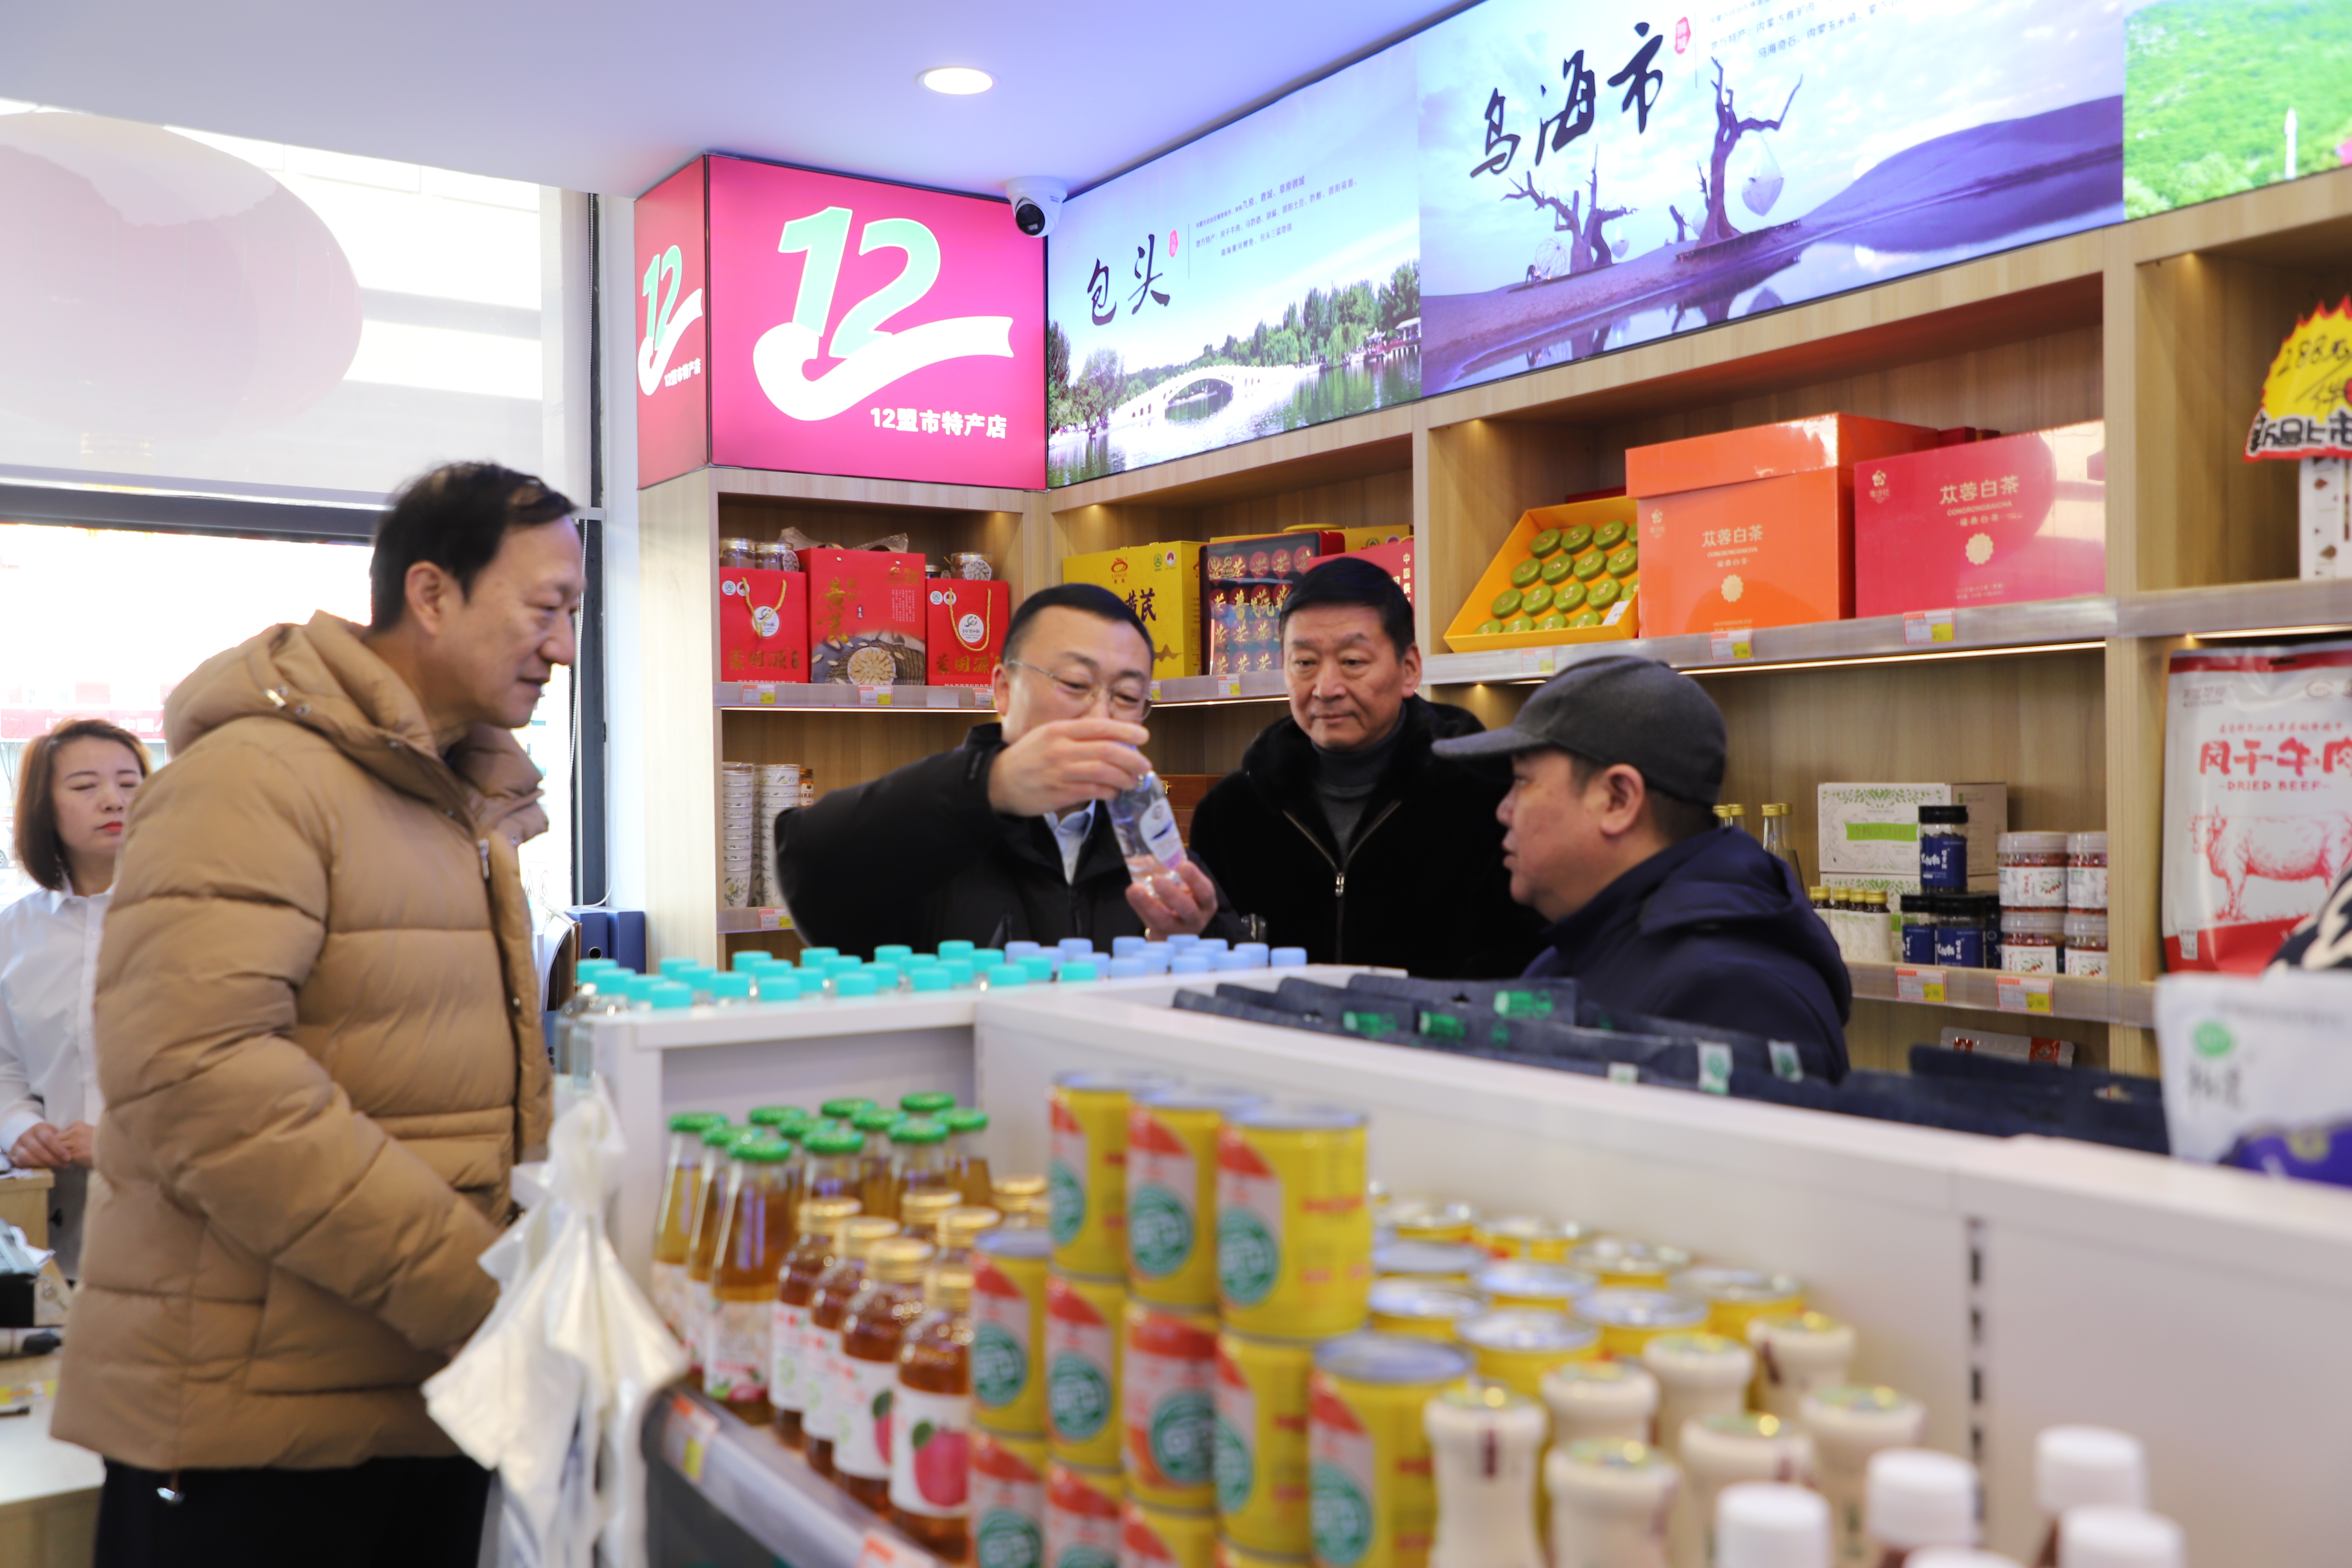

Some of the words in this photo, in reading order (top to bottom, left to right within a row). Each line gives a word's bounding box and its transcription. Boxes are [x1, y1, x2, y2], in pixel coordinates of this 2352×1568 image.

[1471, 22, 1663, 179] 乌海市
[778, 205, 941, 358] 12
[1087, 234, 1170, 326] 包头
[642, 245, 683, 351] 12
[664, 357, 701, 387] 12盟市特产店
[870, 407, 1008, 439] 12盟市特产店
[1939, 475, 2020, 505] 苁蓉白茶
[1947, 501, 2013, 516] CONGRONGBAICHA
[1701, 524, 1764, 547] 苁蓉白茶
[1707, 547, 1758, 558] CONGRONGBAICHA
[2228, 781, 2272, 791] DRIED
[2279, 780, 2320, 791] BEEF
